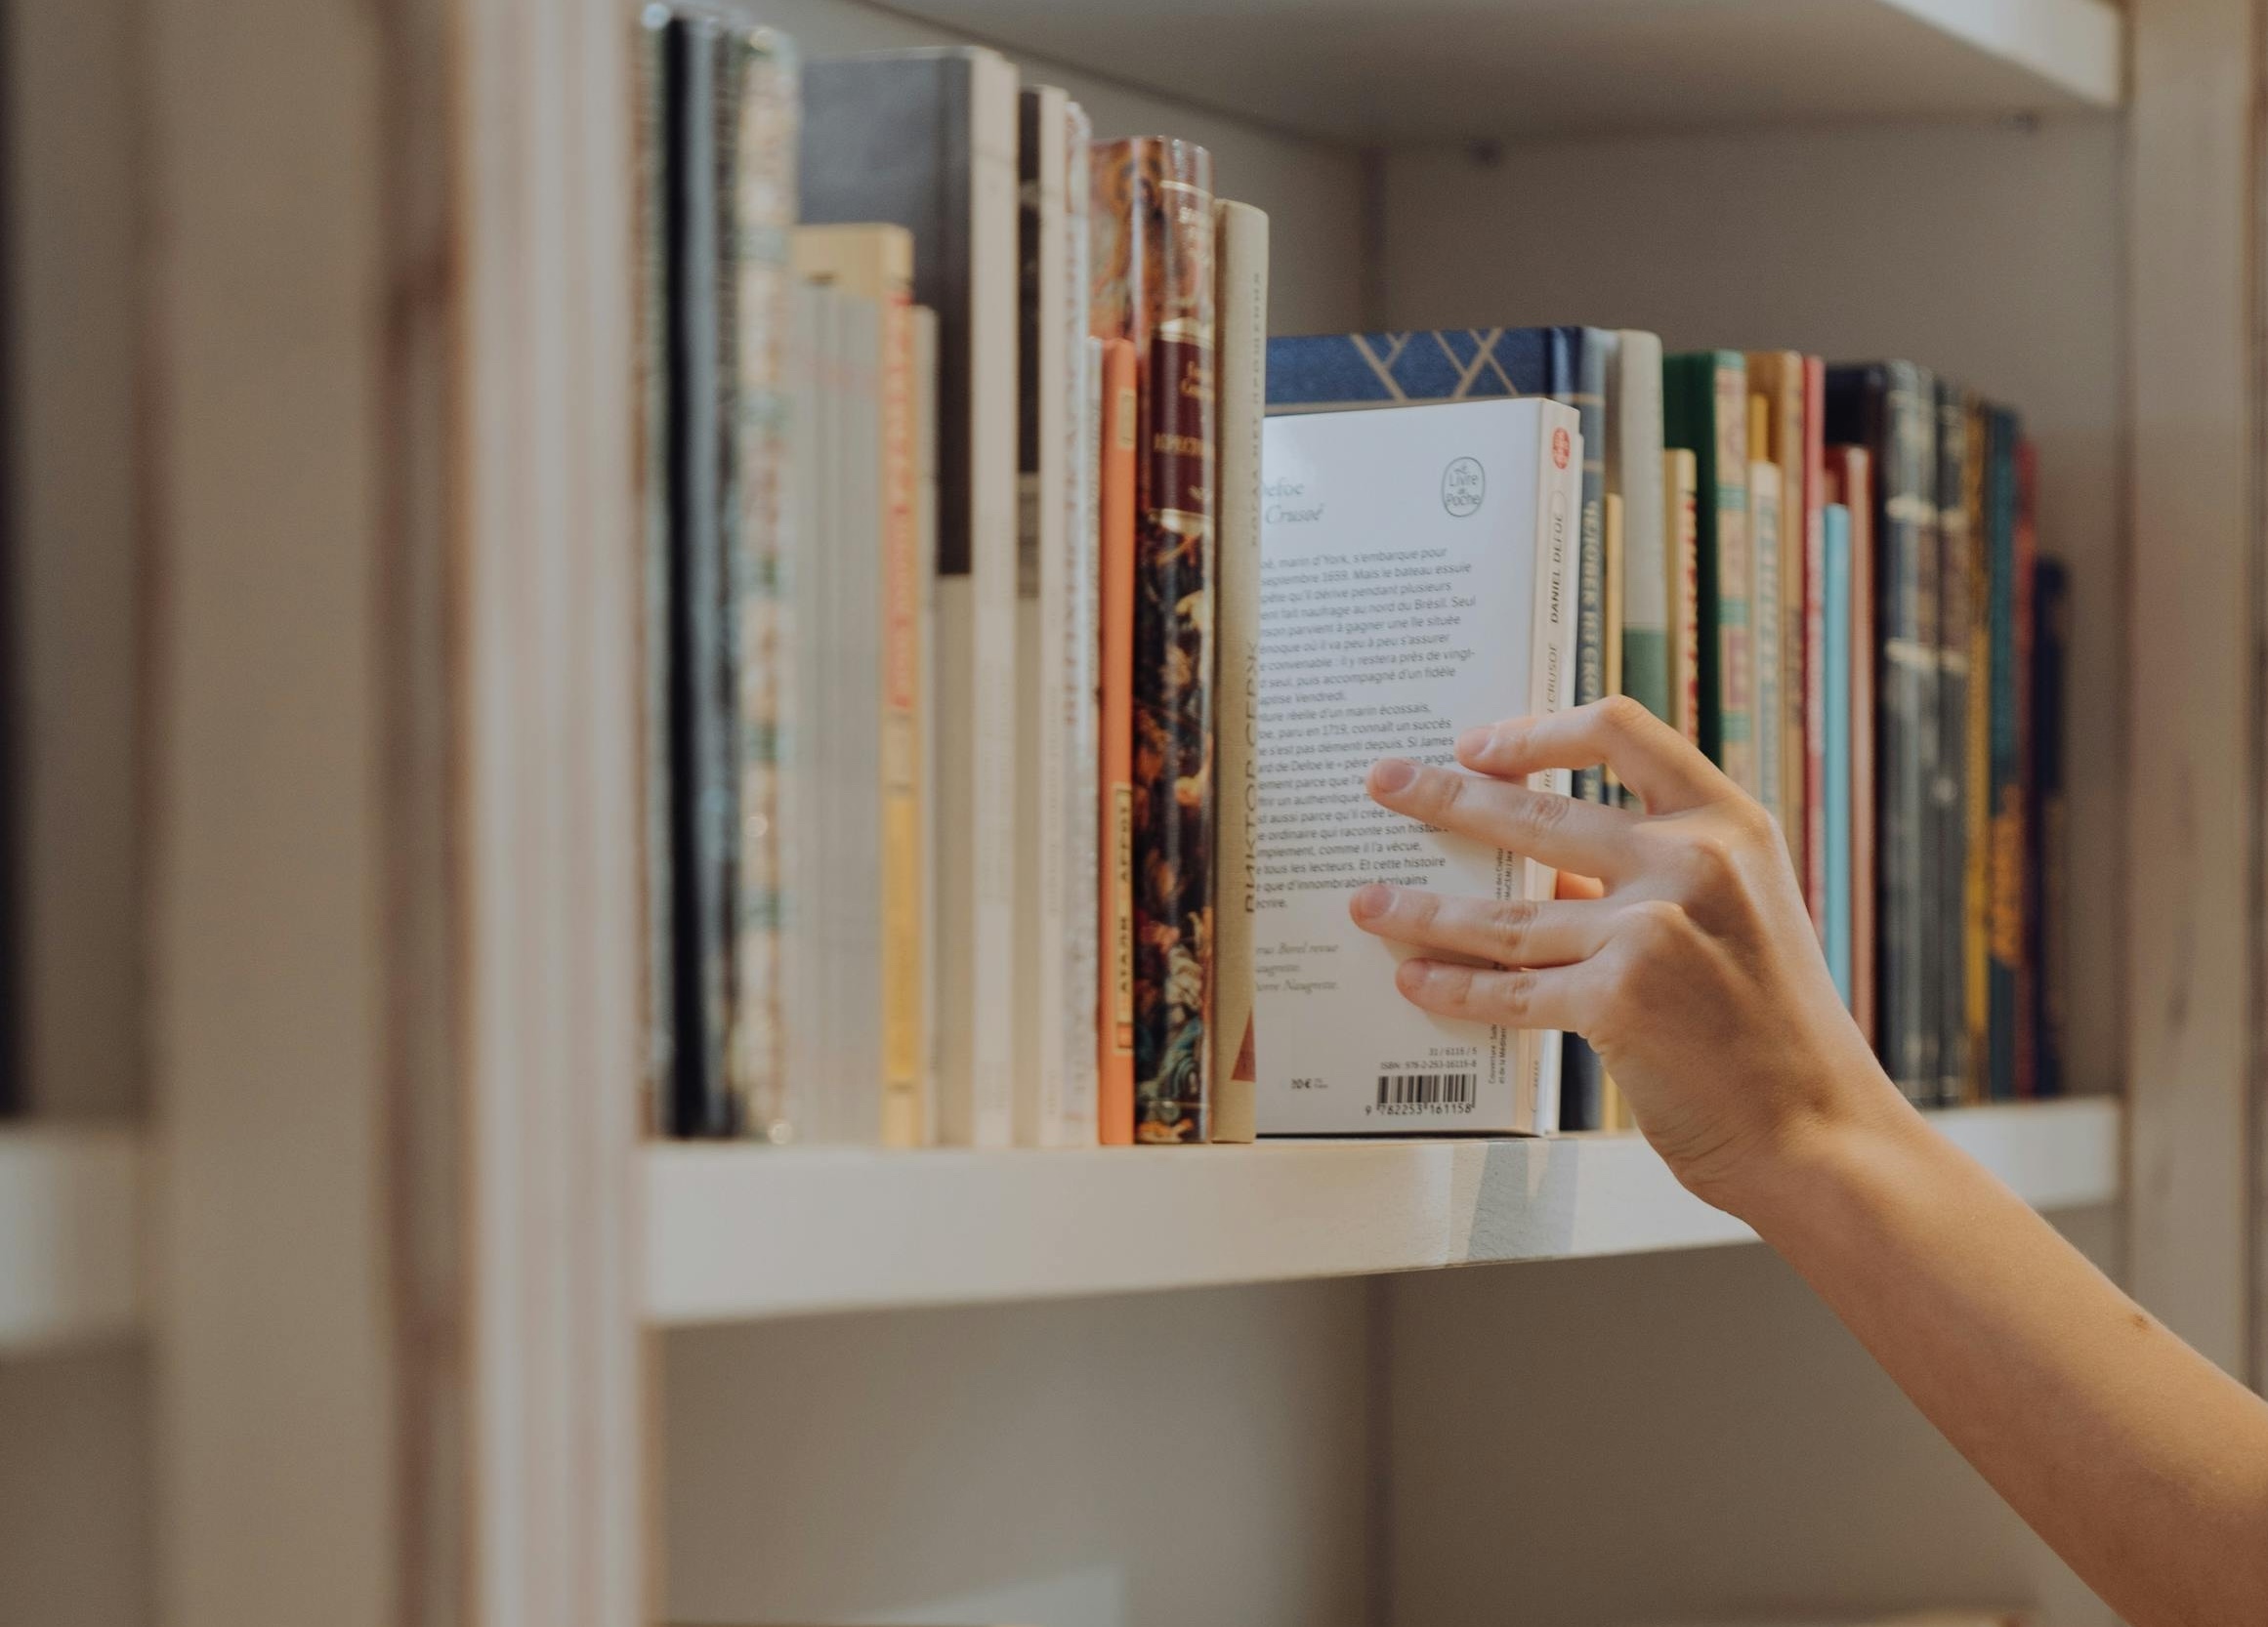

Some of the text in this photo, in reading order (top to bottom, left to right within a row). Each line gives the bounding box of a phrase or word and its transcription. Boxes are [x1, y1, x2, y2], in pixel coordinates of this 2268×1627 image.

[1263, 477, 1305, 497] efoe
[1449, 473, 1478, 487] Livre
[1446, 492, 1482, 506] Poche
[1265, 501, 1324, 524] Crusoé
[1552, 513, 1564, 563] DEFOE
[1280, 557, 1310, 567] marin
[1353, 550, 1418, 563] s'embarque
[1420, 547, 1448, 560] pour
[1261, 573, 1319, 588] septembre
[1352, 567, 1379, 579] Mais
[1382, 566, 1393, 578] le
[1394, 565, 1432, 578] bateau
[1435, 563, 1472, 574] essuie
[1352, 584, 1398, 600] pendant
[1400, 581, 1452, 597] plusieurs
[1550, 569, 1562, 624] DANIEL
[1300, 605, 1351, 618] naufrage
[1353, 605, 1366, 614] au
[1368, 600, 1396, 613] nord
[1398, 599, 1412, 611] du
[1413, 596, 1448, 610] Brésil.
[1451, 594, 1477, 608] Seul
[1344, 621, 1385, 636] gagner
[1387, 619, 1408, 630] une
[1426, 614, 1461, 627] située
[1328, 641, 1341, 650] va
[1343, 640, 1366, 653] peu
[1375, 638, 1399, 651] peu
[1399, 633, 1450, 647] s'assurer
[1268, 657, 1332, 671] convenable
[1359, 653, 1396, 666] restera
[1399, 651, 1425, 666] près
[1426, 649, 1440, 662] de
[1442, 647, 1476, 662] vingt-
[1296, 675, 1320, 688] puis
[1322, 670, 1395, 687] accompagné
[1398, 667, 1423, 681] d'un
[1424, 664, 1456, 678] fidèle
[1319, 706, 1344, 719] d'un
[1345, 705, 1377, 716] marin
[1378, 701, 1432, 715] écossais,
[1278, 727, 1303, 740] paru
[1305, 727, 1321, 737] en
[1351, 721, 1395, 733] connaît
[1396, 721, 1411, 731] un
[1411, 717, 1452, 730] succès
[1295, 743, 1316, 757] pas
[1317, 739, 1363, 754] démenti
[1364, 737, 1405, 753] depuis.
[1407, 734, 1417, 748] Si
[1419, 734, 1454, 748] James
[1275, 761, 1289, 773] de
[1290, 758, 1323, 773] Defoe
[1324, 757, 1335, 770] le
[1344, 756, 1368, 771] père
[1295, 777, 1326, 791] parce
[1328, 776, 1349, 789] que
[1277, 795, 1291, 806] un
[1293, 790, 1361, 806] authentique
[1270, 810, 1298, 823] aussi
[1300, 810, 1331, 824] parce
[1360, 806, 1386, 819] crée
[1268, 826, 1318, 840] ordinaire
[1320, 826, 1338, 841] qui
[1339, 824, 1383, 838] raconte
[1385, 824, 1407, 835] son
[1319, 843, 1360, 856] comme
[1385, 840, 1423, 853] vécue,
[1263, 862, 1288, 875] tous
[1289, 861, 1307, 874] les
[1308, 858, 1355, 873] lecteurs.
[1359, 857, 1371, 871] Et
[1372, 857, 1402, 870] cette
[1403, 854, 1447, 868] histoire
[1263, 880, 1284, 894] que
[1445, 1047, 1464, 1056] 6115
[1365, 1103, 1472, 1116] 9 782253 161158
